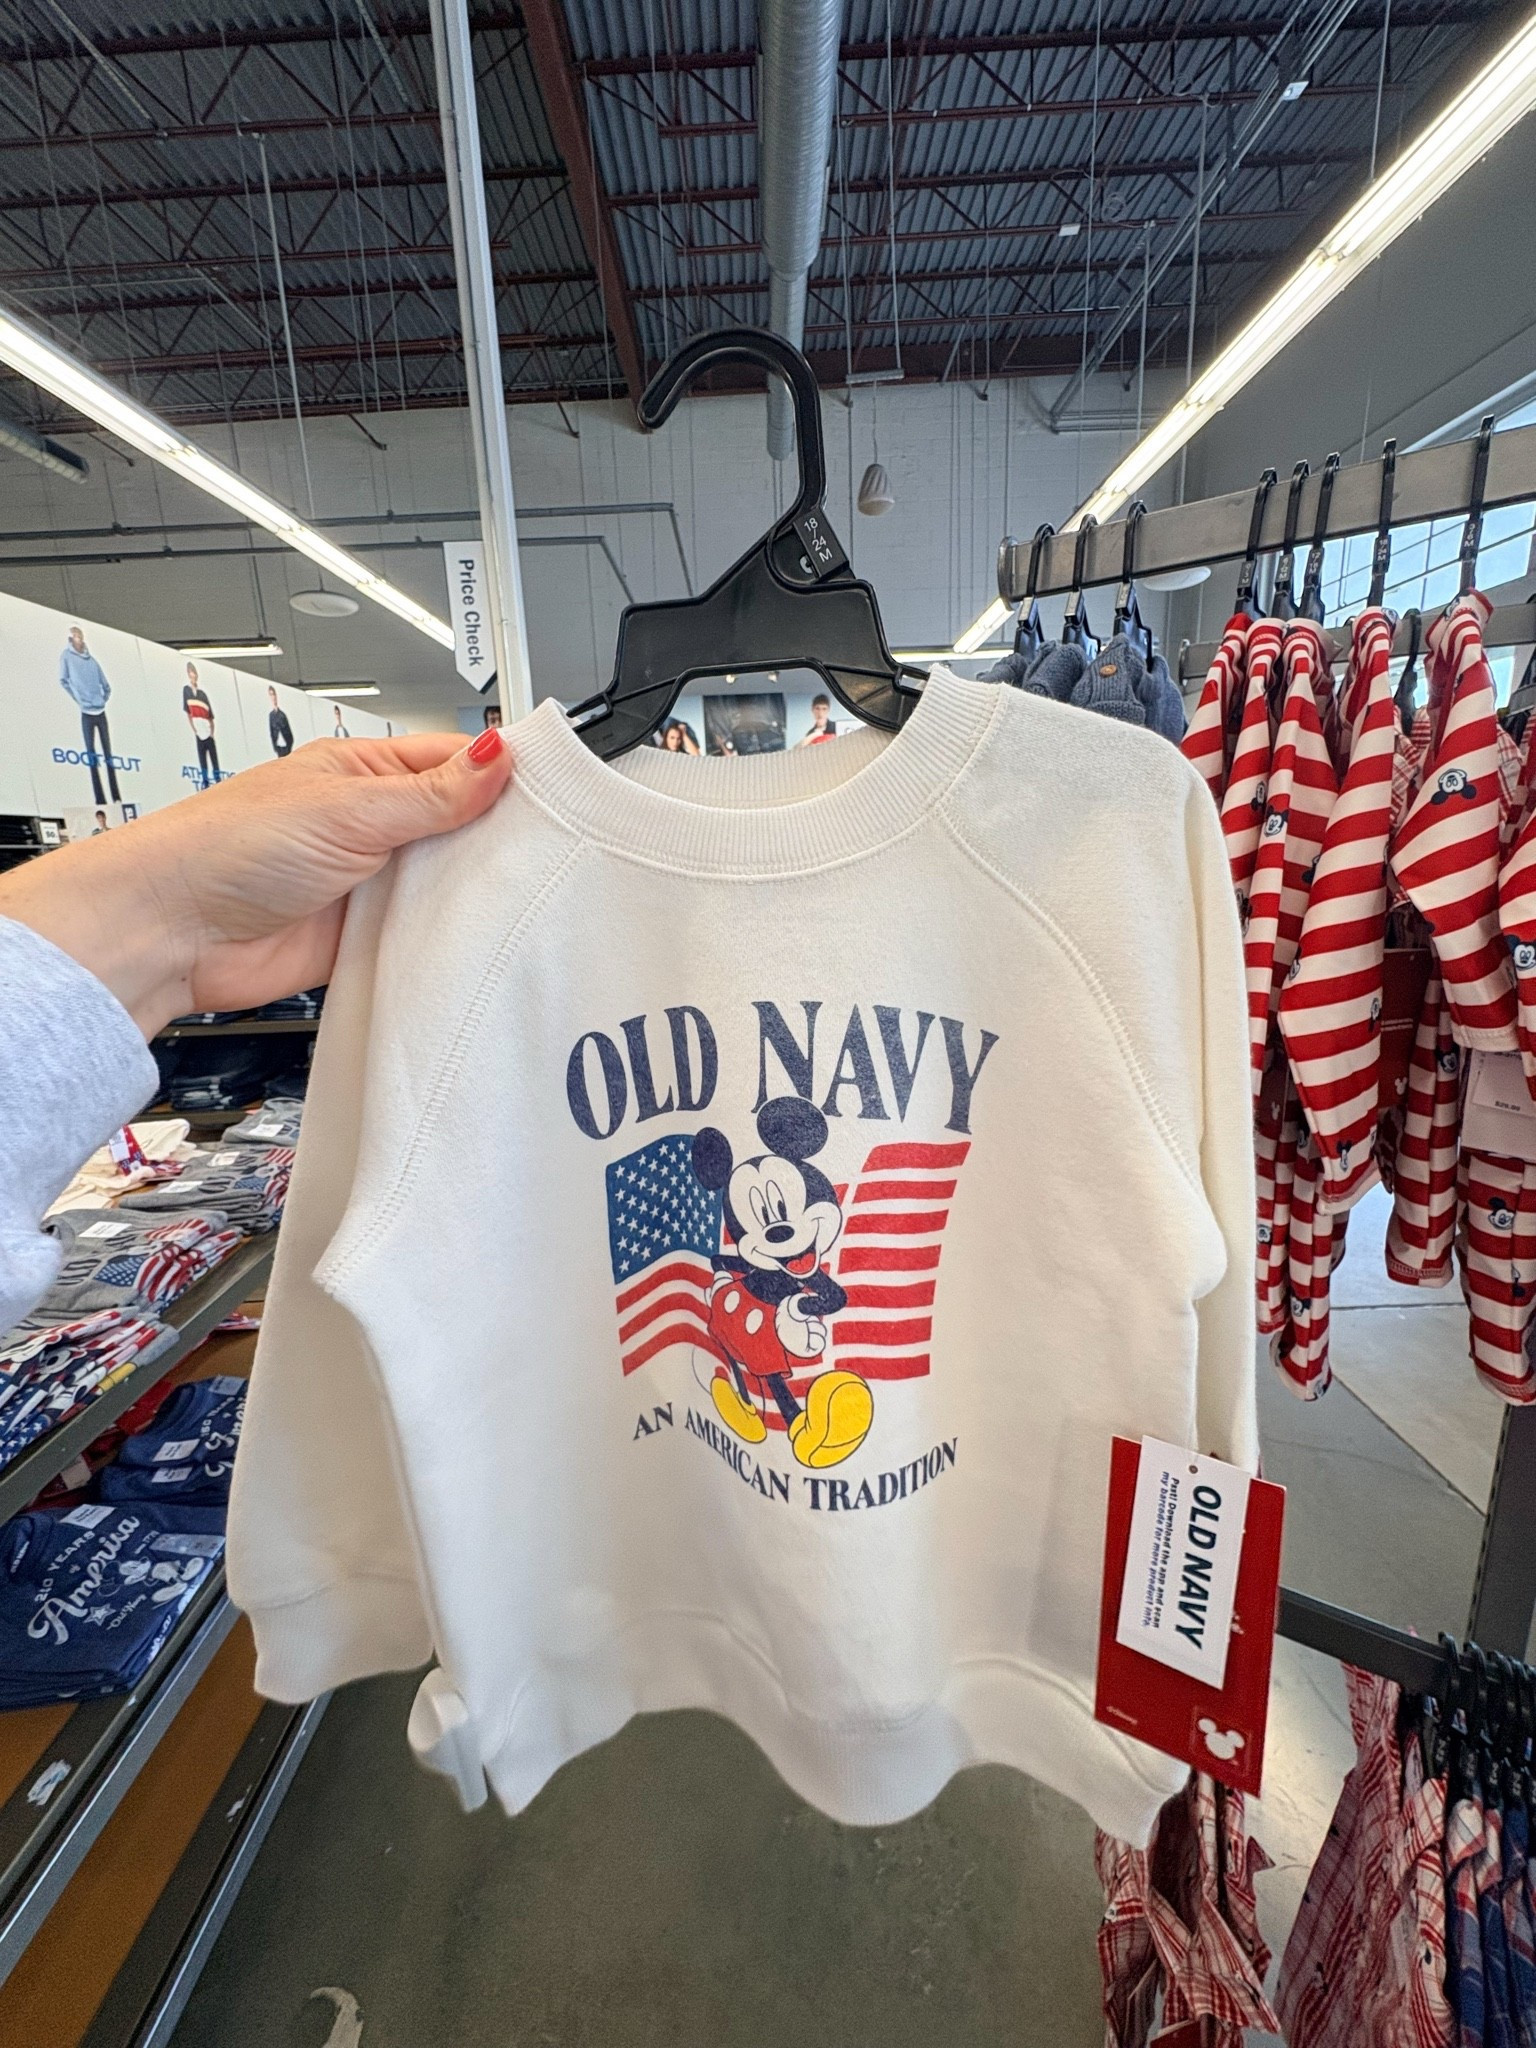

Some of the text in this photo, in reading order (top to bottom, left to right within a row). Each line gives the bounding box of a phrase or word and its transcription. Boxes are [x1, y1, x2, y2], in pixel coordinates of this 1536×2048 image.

[803, 517, 818, 532] 18
[811, 535, 827, 551] 24
[818, 548, 833, 563] M
[458, 559, 485, 667] Price Check
[566, 1001, 999, 1140] OLD NAVY
[632, 1402, 959, 1512] AN AMERICAN TRADITION
[1160, 1471, 1170, 1487] my
[1156, 1487, 1169, 1526] barcode
[1153, 1526, 1163, 1542] for
[1162, 1502, 1177, 1549] Download
[48, 1530, 96, 1572] YEARS
[1151, 1542, 1160, 1567] more
[1159, 1549, 1170, 1566] the
[27, 1515, 141, 1645] America
[1156, 1567, 1167, 1585] app
[1175, 1485, 1222, 1650] OLD NAVY
[1145, 1567, 1157, 1606] product
[1154, 1586, 1164, 1606] and
[1152, 1606, 1161, 1629] scan
